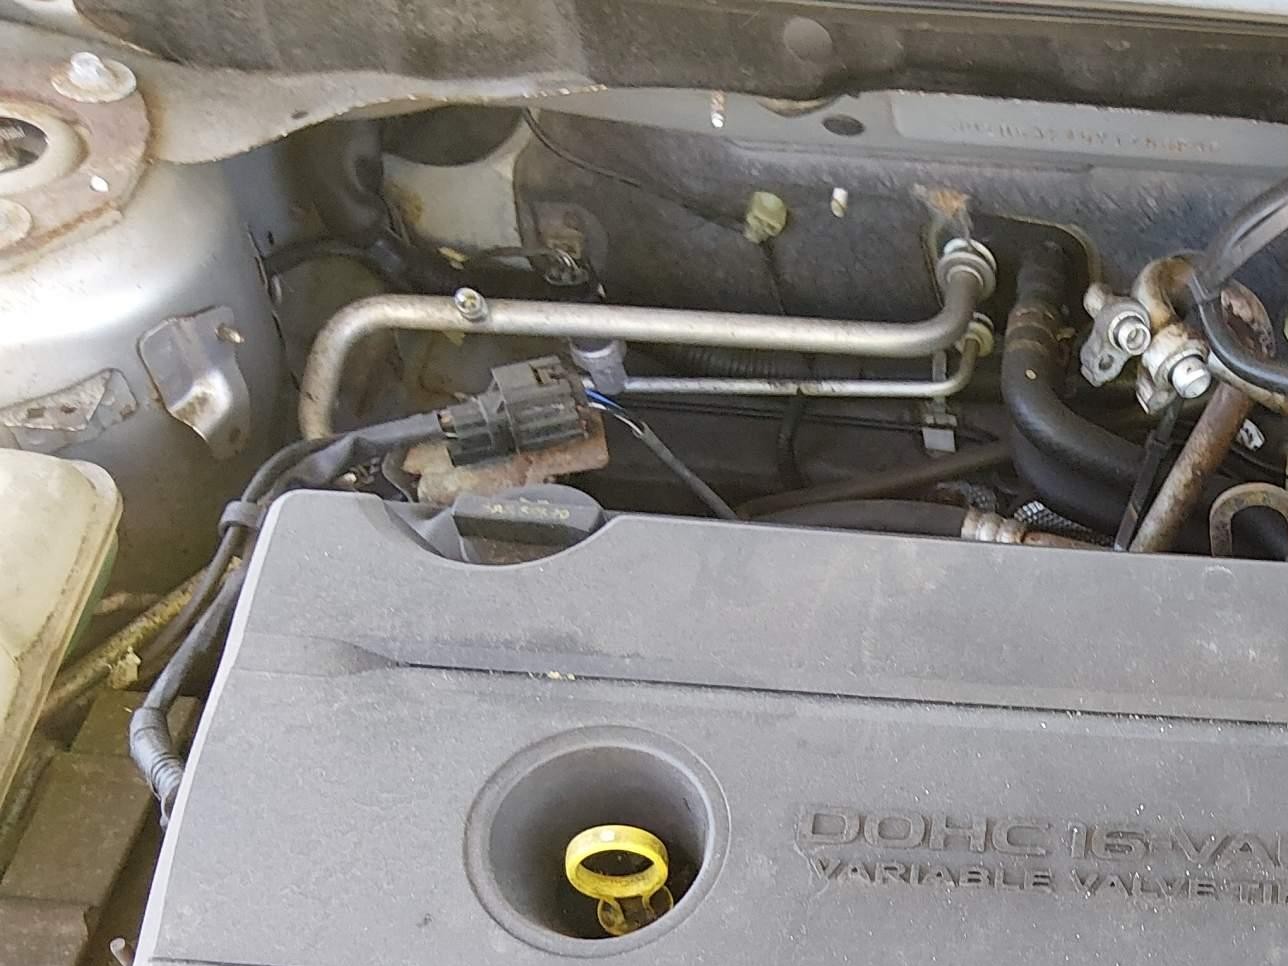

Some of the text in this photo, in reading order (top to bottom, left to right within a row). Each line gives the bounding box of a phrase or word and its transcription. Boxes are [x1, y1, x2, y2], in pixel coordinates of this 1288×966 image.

[799, 807, 1051, 856] DOHC
[808, 855, 1054, 891] VARIABLE
[1068, 869, 1217, 902] VALVE
